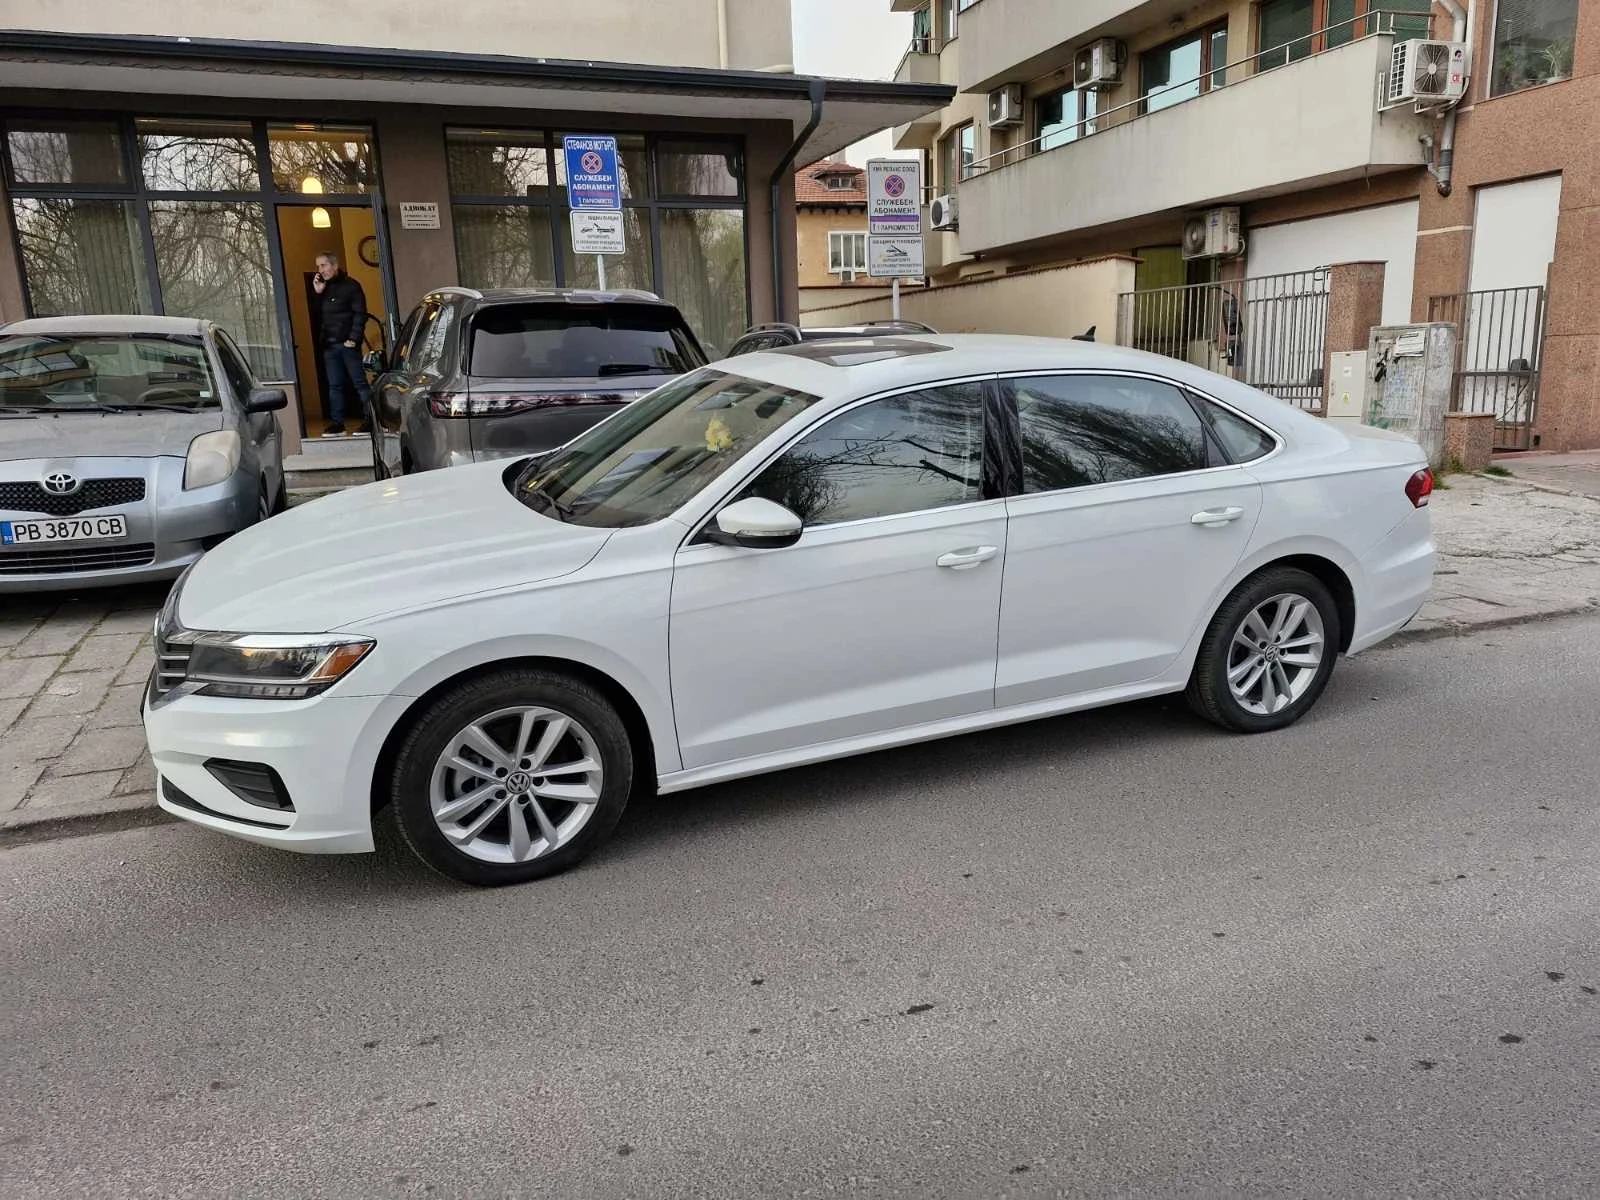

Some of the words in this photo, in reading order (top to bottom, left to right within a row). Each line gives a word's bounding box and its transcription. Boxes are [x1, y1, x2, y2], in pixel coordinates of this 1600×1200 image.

[574, 174, 612, 182] СЛУЖЕБЕН
[14, 523, 42, 541] PB
[46, 520, 93, 538] 3870
[97, 518, 123, 536] CB
